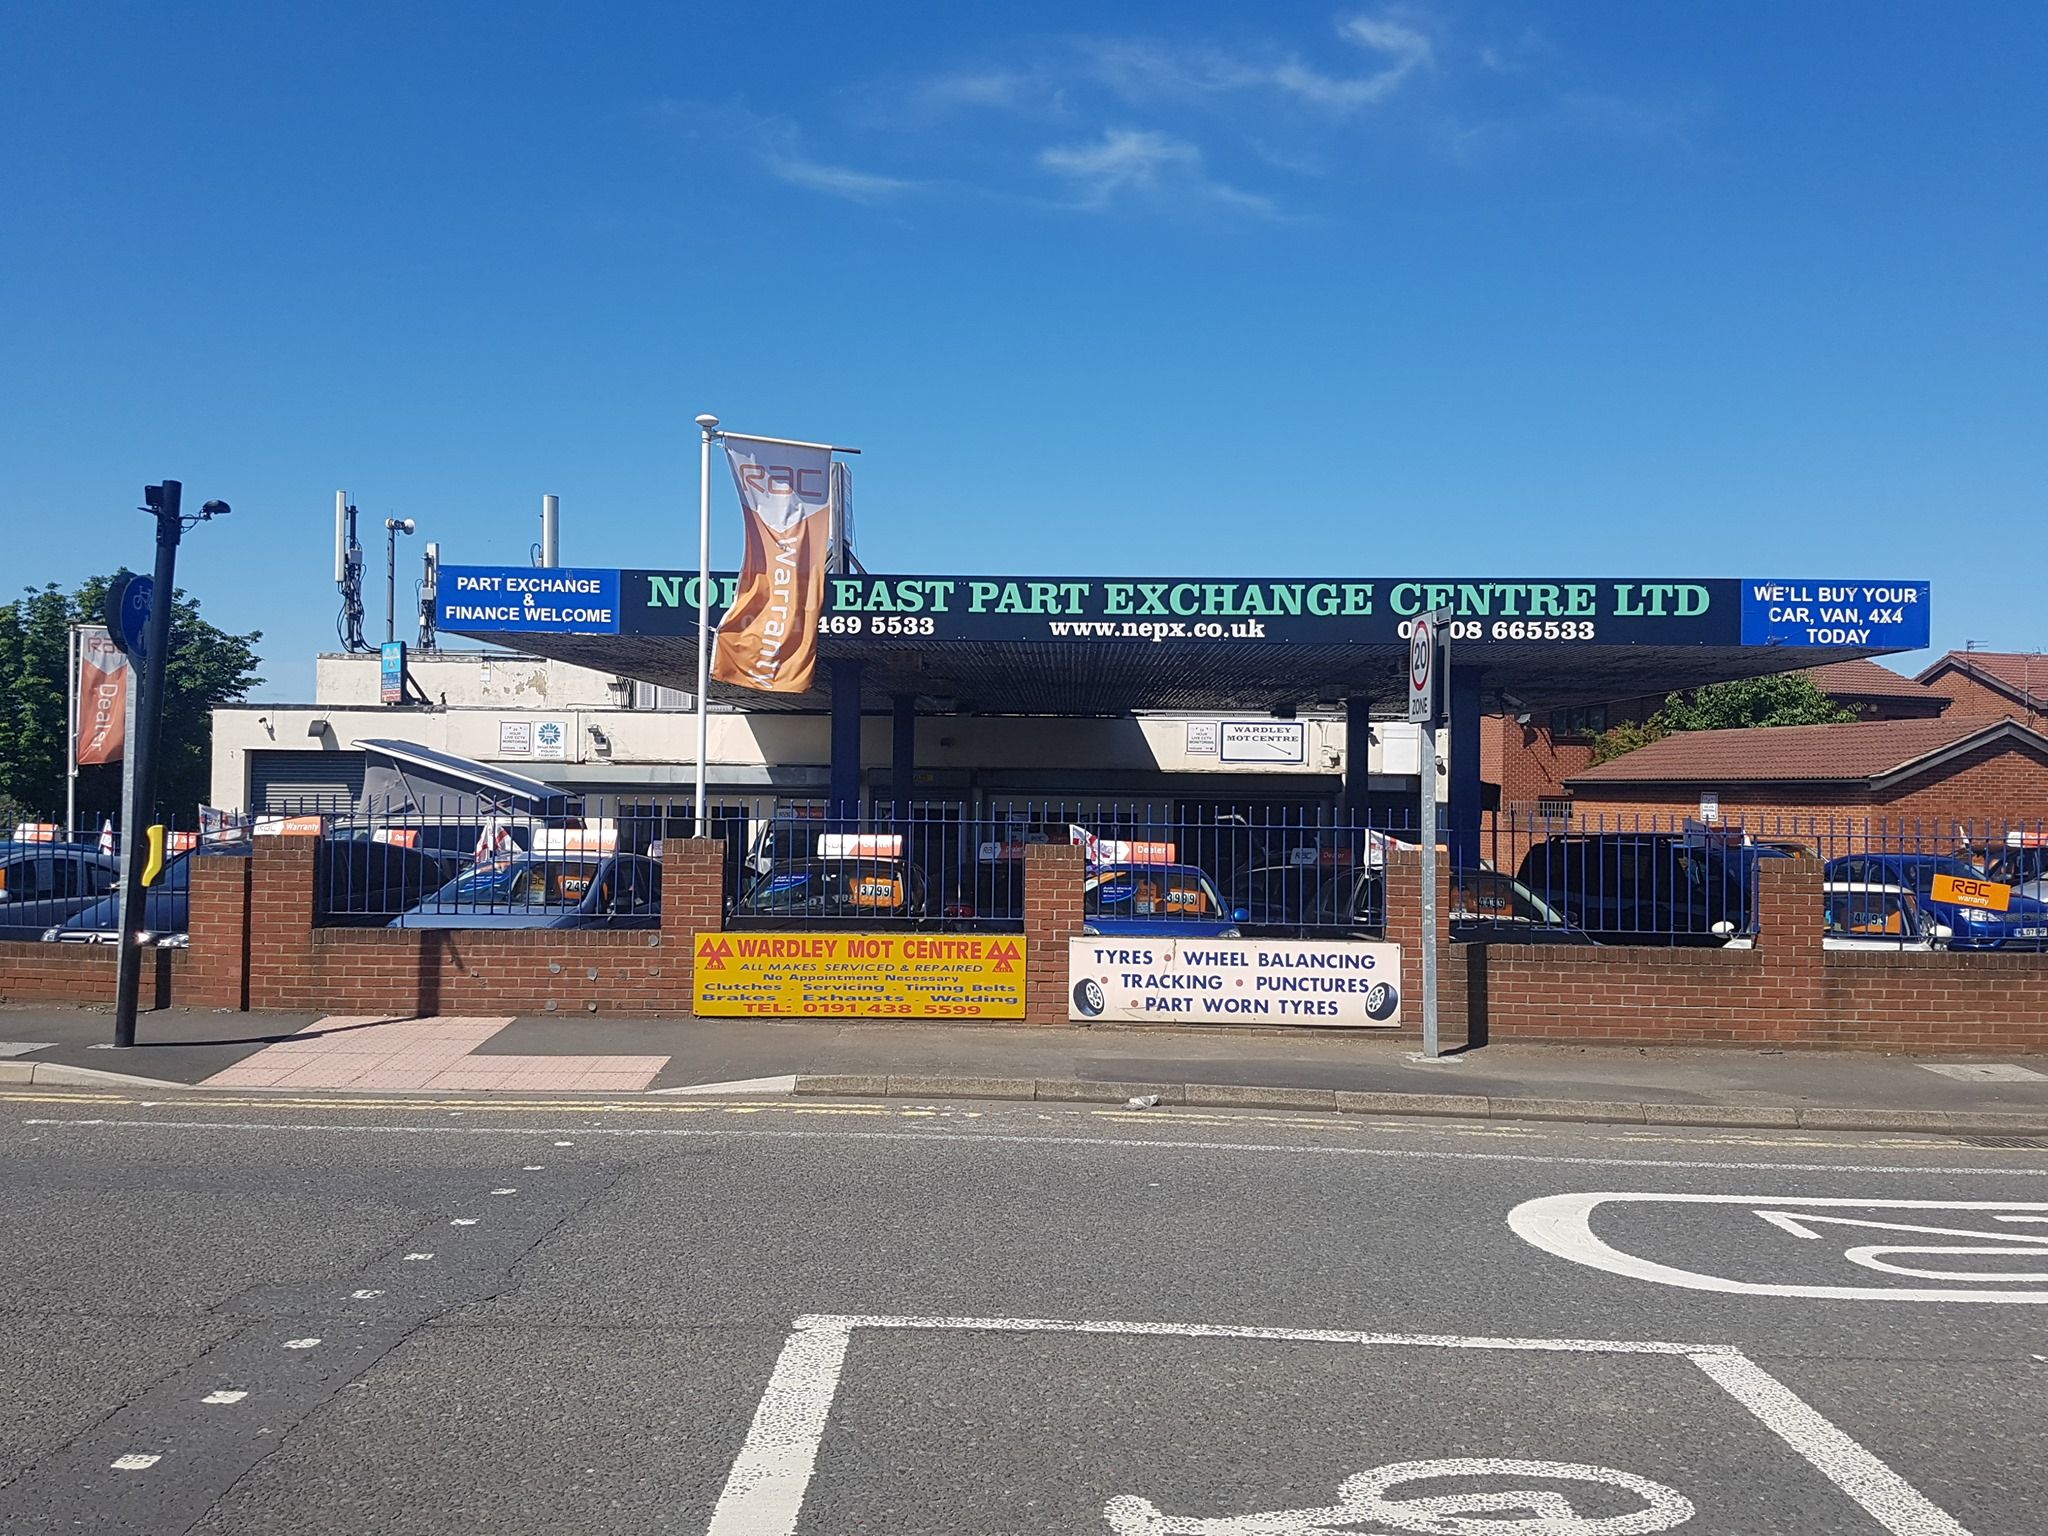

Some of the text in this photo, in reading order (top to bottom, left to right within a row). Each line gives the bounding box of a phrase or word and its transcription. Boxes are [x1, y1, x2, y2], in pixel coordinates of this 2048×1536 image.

[457, 576, 600, 593] PART EXCHANGE
[523, 593, 535, 607] &
[832, 580, 955, 612] EAST
[969, 582, 1089, 614] PART
[1104, 583, 1373, 616] EXCHANGE
[1390, 583, 1597, 616] CENTRE
[1613, 584, 1711, 616] LTD
[1818, 586, 1858, 603] BUY
[1863, 586, 1918, 603] YOUR
[445, 606, 612, 623] FINANCE WELCOME
[1769, 607, 1809, 626] CAR,
[1819, 608, 1863, 627] VAN,
[871, 617, 935, 635] 5533
[1049, 619, 1265, 641] www.nepx.co.uk
[1397, 620, 1595, 640] 008 665533
[1806, 628, 1870, 645] TODAY
[1414, 641, 1427, 671] 20
[1412, 697, 1428, 715] ZONE
[91, 683, 118, 751] Dealer
[286, 822, 319, 832] Warranty
[1137, 846, 1166, 854] Dealer
[861, 885, 890, 896] 3799
[1167, 892, 1195, 903] 3999
[1958, 895, 1989, 905] warranty
[737, 939, 982, 959] WARDLEY MOT CENTRE
[740, 963, 983, 972] ALL MAKES SERVICED & REPAIRED
[1094, 949, 1376, 969] TYRES WHEEL BALANCING
[763, 973, 959, 983] No Appointment Necessary
[1121, 973, 1369, 992] TRACKING PUNCTURES
[704, 983, 1016, 993] Clutches Servicing Timing Belts
[702, 993, 1018, 1004] Brakes Exhausts Welding
[1145, 997, 1339, 1015] PART WORN TYRES
[744, 1004, 981, 1015] TEL: 0191 438 5599
